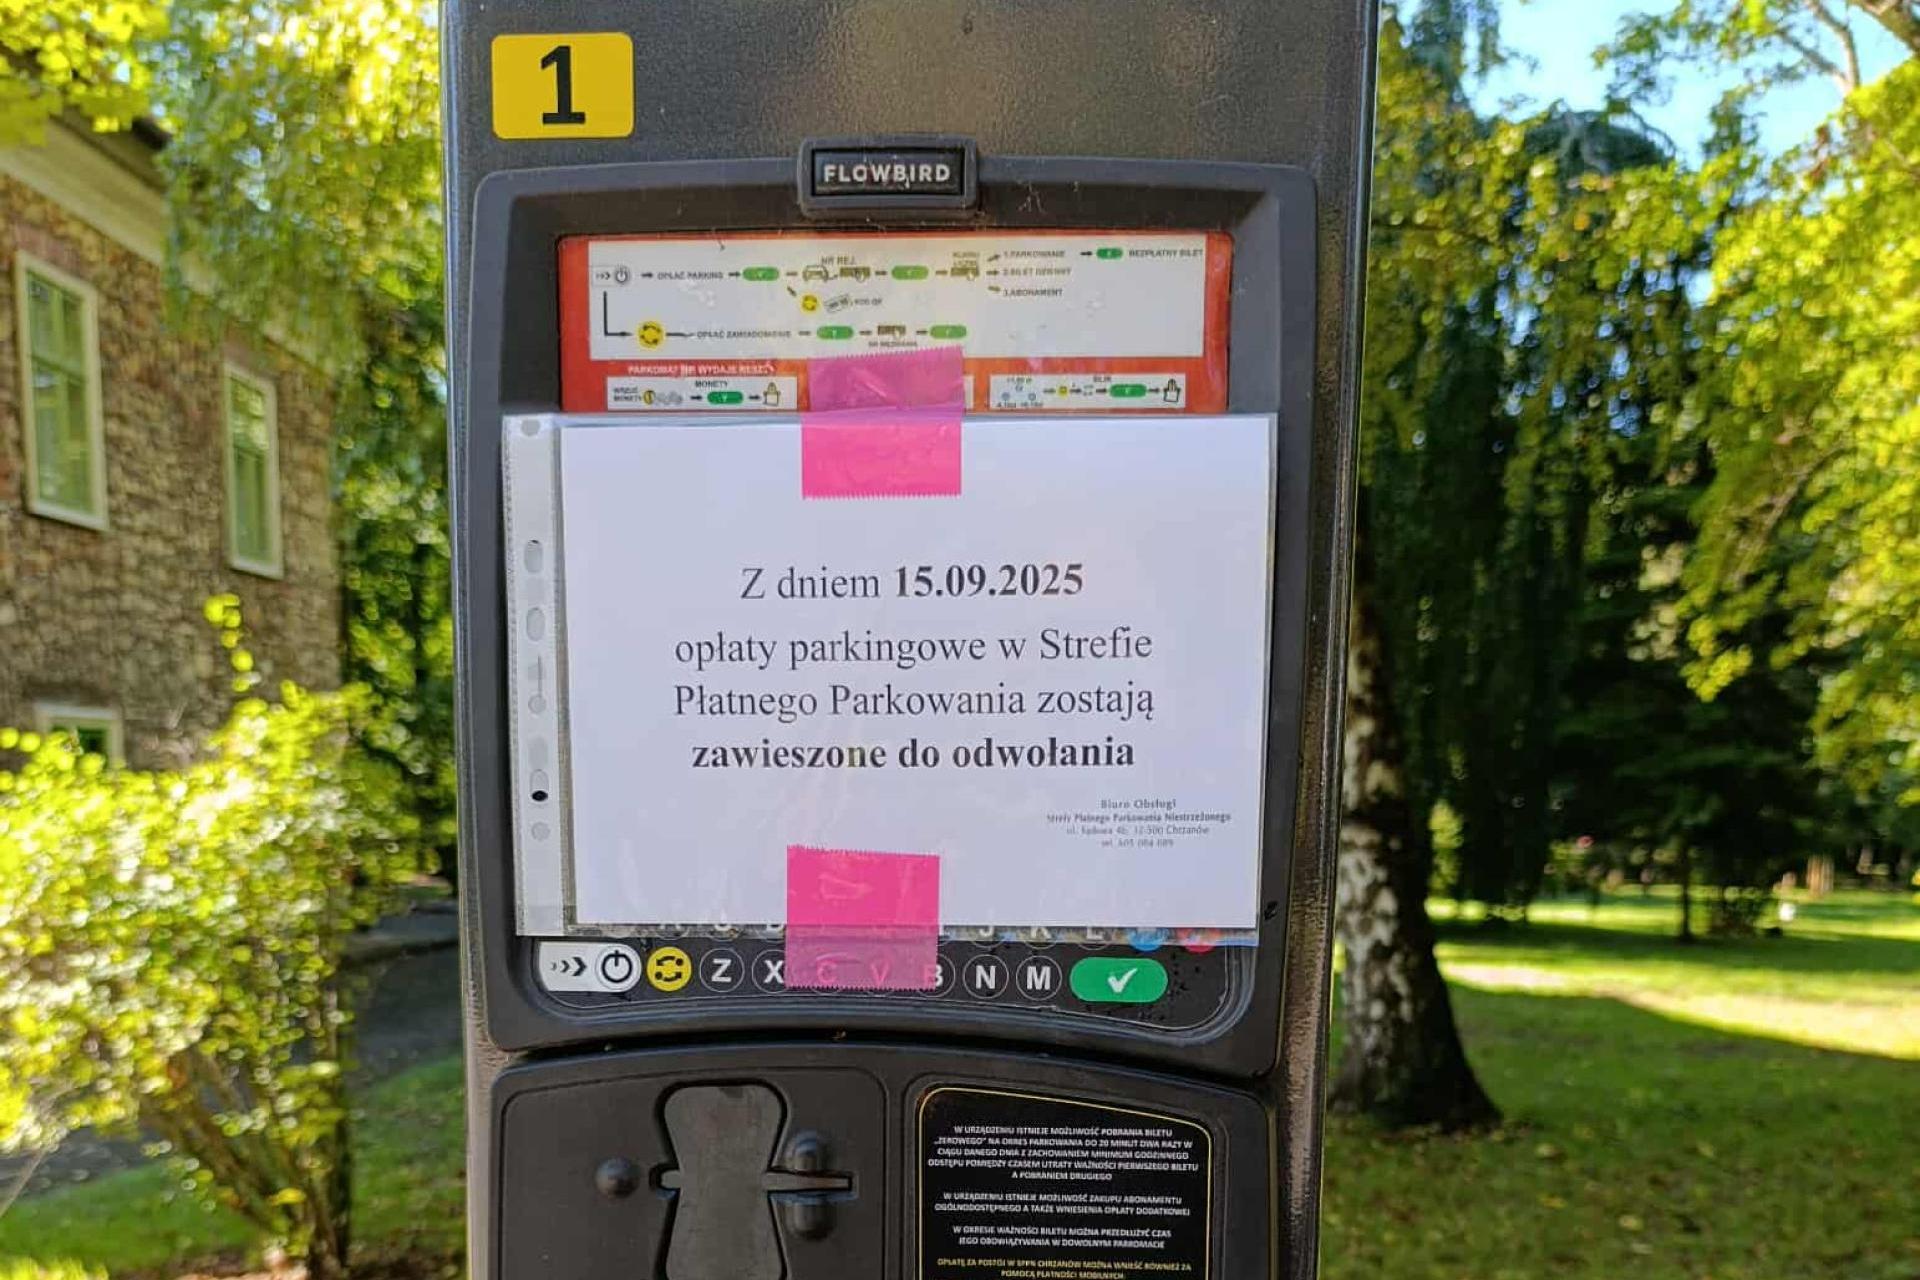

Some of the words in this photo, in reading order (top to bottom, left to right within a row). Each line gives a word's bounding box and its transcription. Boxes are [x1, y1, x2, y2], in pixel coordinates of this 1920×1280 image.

[541, 46, 585, 124] 1
[824, 164, 950, 183] FLOWBIRD
[687, 271, 723, 280] PARKING
[694, 380, 728, 388] MONETY
[740, 567, 767, 600] Z
[777, 566, 880, 599] dniem
[895, 563, 1084, 598] 15.09.2025
[675, 630, 777, 671] opłaty
[789, 629, 986, 669] parkingowe
[998, 637, 1026, 660] w
[1039, 626, 1153, 660] Strefie
[674, 683, 817, 723] Płatnego
[828, 683, 1026, 716] Parkowania
[1037, 681, 1153, 721] zostają
[691, 738, 887, 769] zawieszone
[897, 737, 940, 768] do
[952, 736, 1135, 767] odwołania
[1101, 799, 1130, 809] Biuro
[1133, 799, 1176, 810] Obsługi
[1074, 813, 1110, 824] Płatnego
[1113, 813, 1162, 821] Parkowania
[1165, 812, 1232, 823] Niestrzeżonego
[1166, 824, 1209, 834] Chrzanów
[711, 959, 732, 983] Z
[763, 960, 785, 983] X
[974, 965, 997, 989] N
[1026, 966, 1051, 990] M
[954, 1126, 963, 1134] W
[964, 1126, 1014, 1135] URZĄDZENIU
[1016, 1127, 1049, 1135] ISTNIEJE
[1050, 1126, 1100, 1136] MOŻLIWOŚĆ
[1101, 1128, 1143, 1136] POBRANIA
[1145, 1129, 1173, 1137] BILETU
[1029, 1138, 1083, 1146] PARKOWANIA
[1098, 1139, 1109, 1147] 20
[1139, 1140, 1160, 1148] DWA
[1183, 1141, 1193, 1149] W
[937, 1148, 962, 1157] CIĄGU
[964, 1148, 998, 1157] DANEGO
[999, 1149, 1019, 1157] DNIA
[1027, 1149, 1089, 1158] ZACHOWANIEM
[1008, 1160, 1040, 1168] CZASEM
[1041, 1160, 1072, 1168] UTRATY
[1171, 1163, 1199, 1171] BILETU
[1070, 1172, 1112, 1180] DRUGIEGO
[943, 1192, 952, 1200] W
[1005, 1193, 1037, 1201] ISTNIEJE
[1089, 1195, 1122, 1203] ZAKUPU
[1123, 1196, 1182, 1204] ABONAMENTU
[1022, 1204, 1029, 1212] A
[1031, 1204, 1054, 1213] TAKŻE
[1056, 1205, 1103, 1214] WNIESIENIA
[953, 1226, 961, 1234] W
[1040, 1227, 1067, 1235] BILETU
[1151, 1229, 1172, 1237] CZAS
[1062, 1239, 1112, 1248] DOWOLNYM
